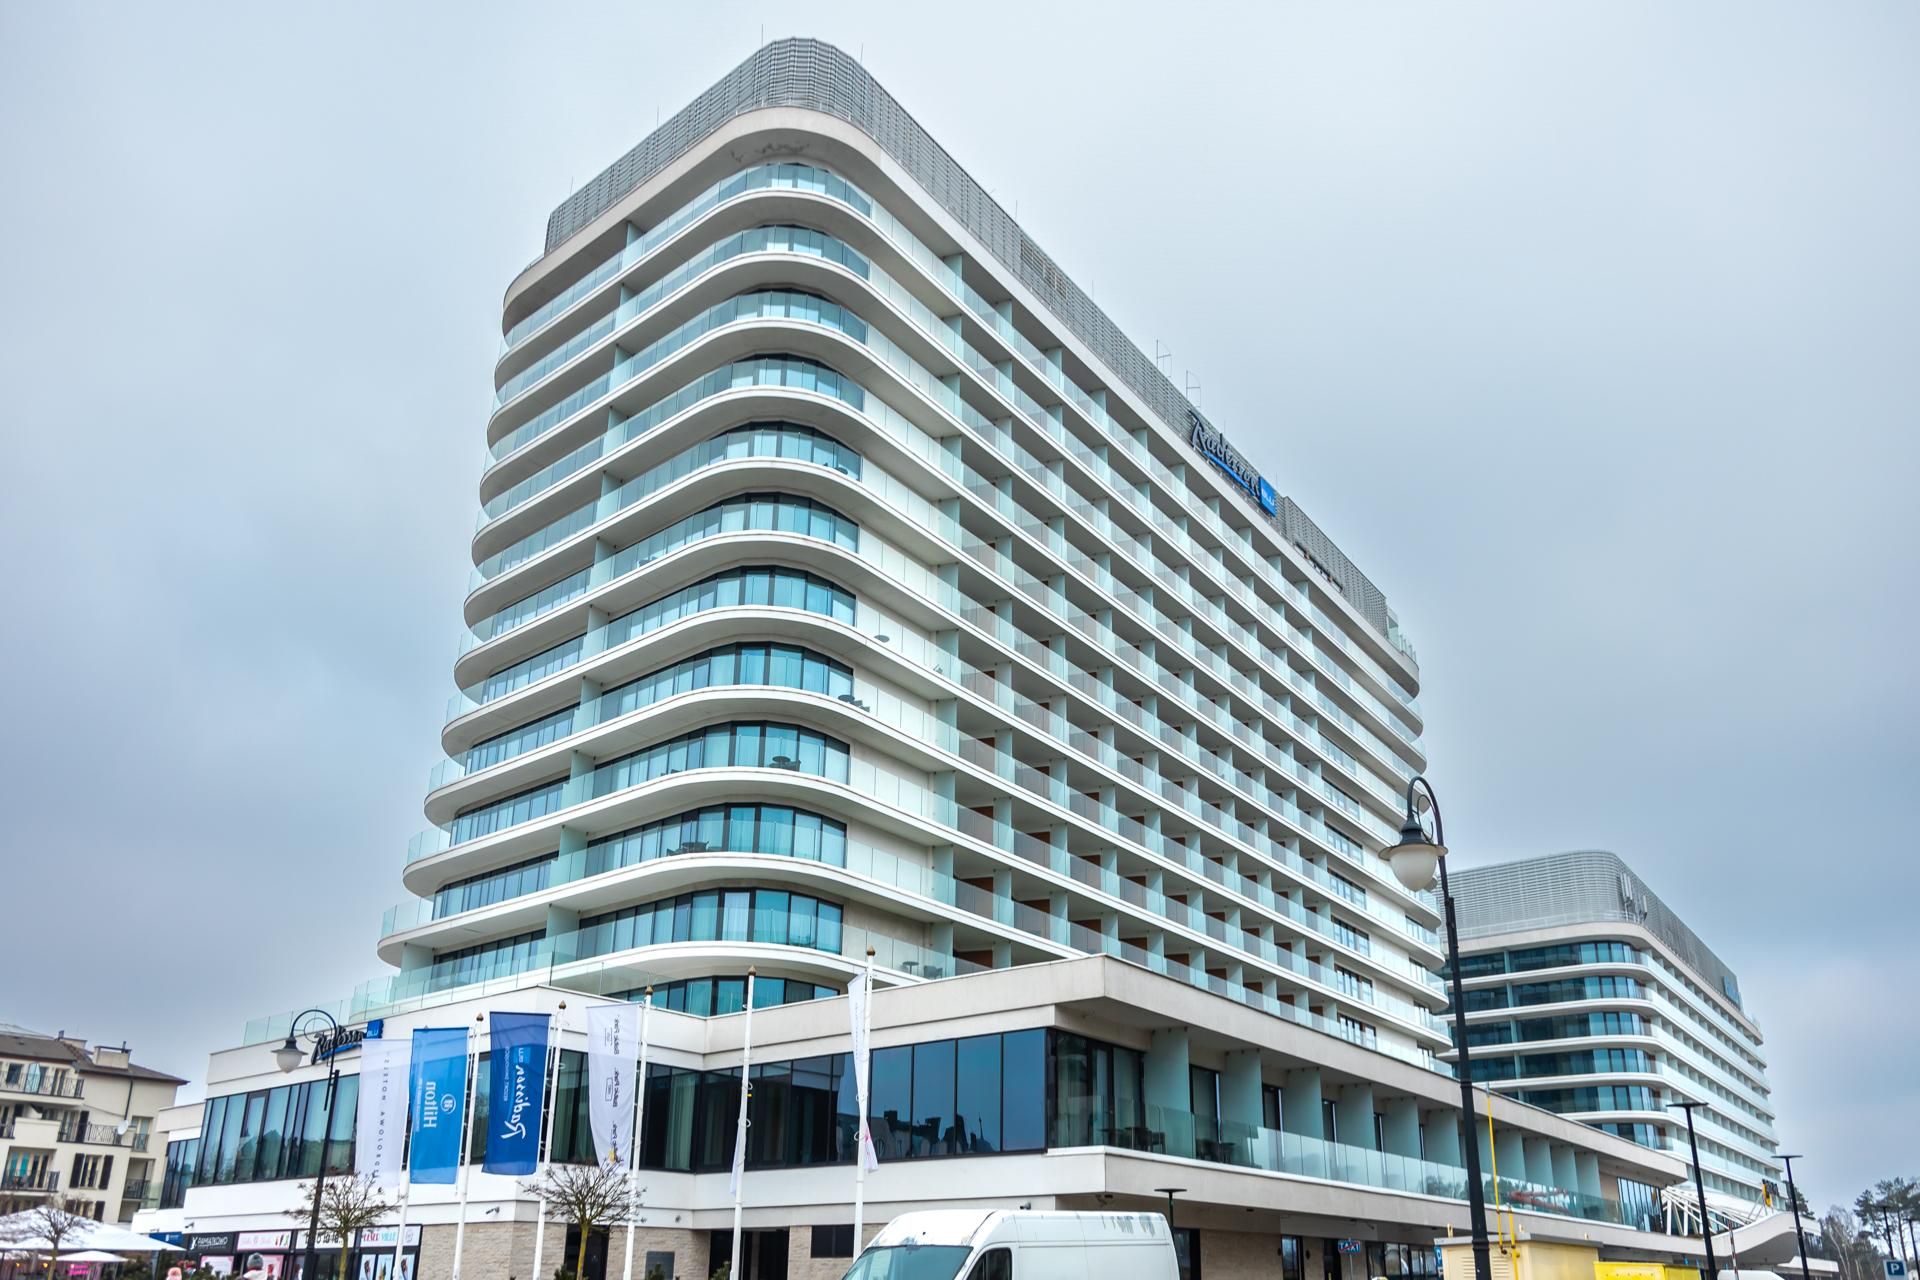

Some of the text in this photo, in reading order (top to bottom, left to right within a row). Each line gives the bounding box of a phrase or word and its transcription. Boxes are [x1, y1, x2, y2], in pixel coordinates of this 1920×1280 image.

[1189, 410, 1261, 497] Radisson
[1339, 1241, 1359, 1252] TAXI
[1890, 1263, 1900, 1275] P
